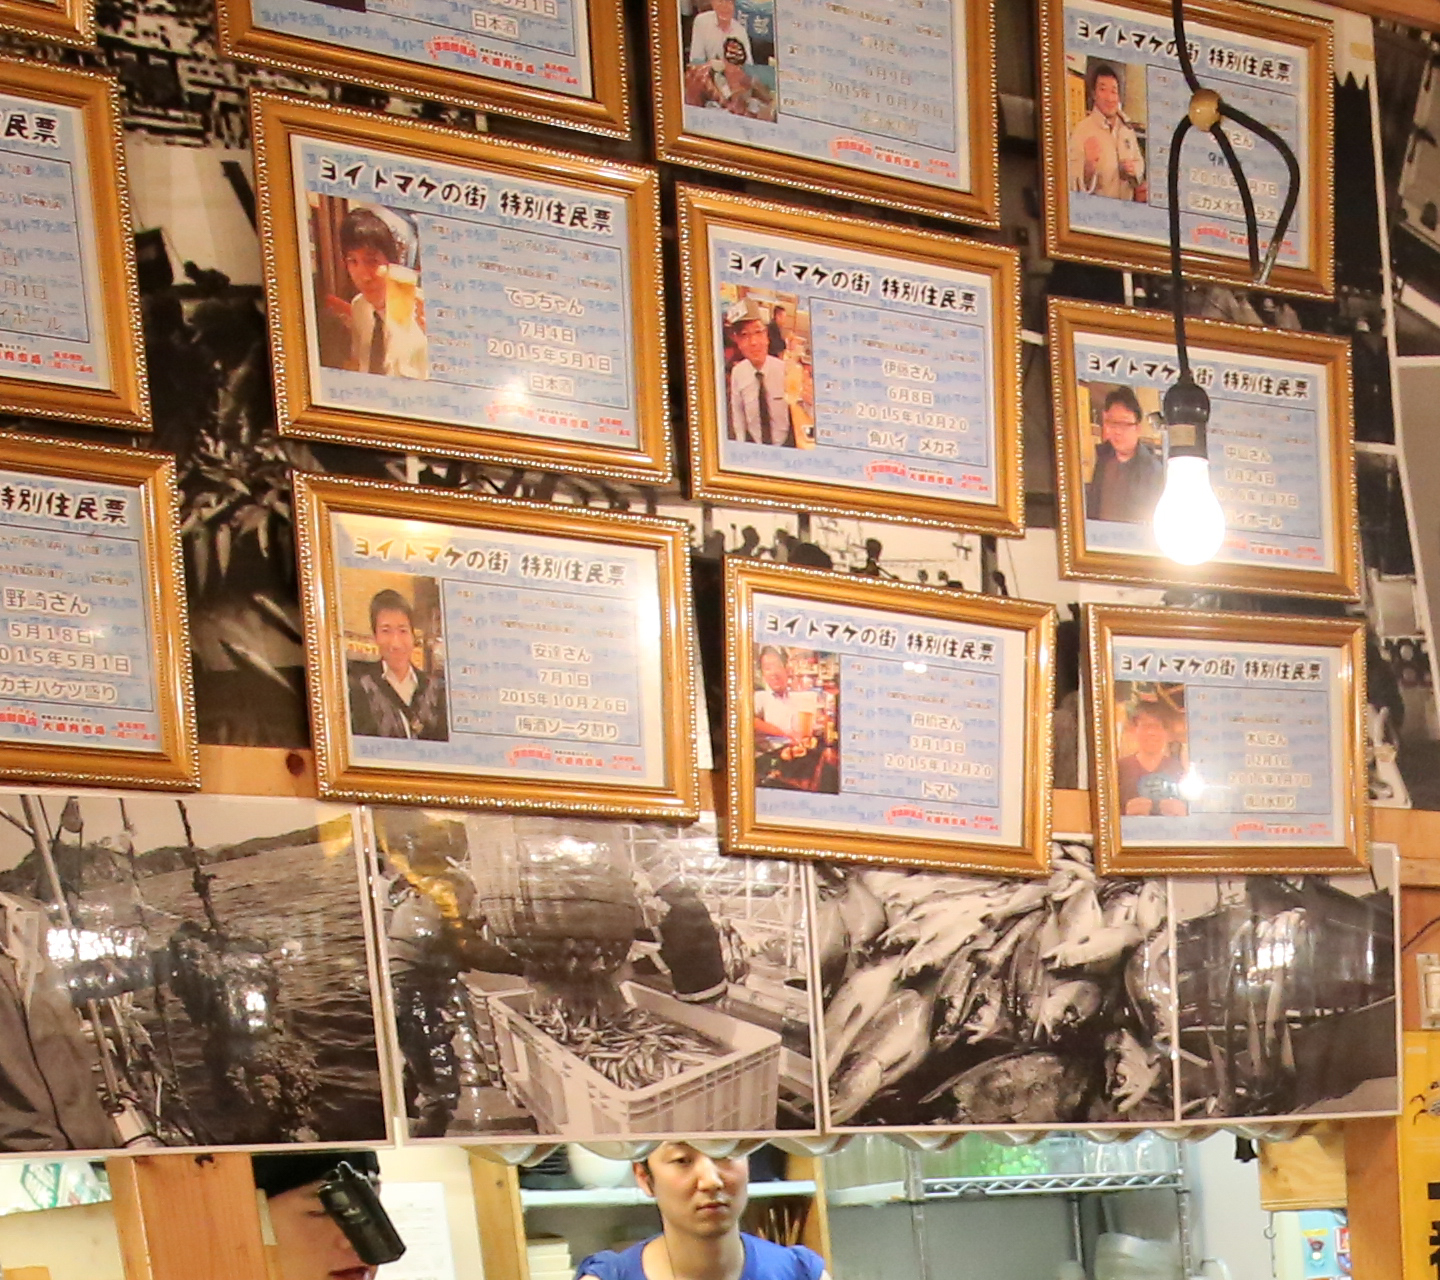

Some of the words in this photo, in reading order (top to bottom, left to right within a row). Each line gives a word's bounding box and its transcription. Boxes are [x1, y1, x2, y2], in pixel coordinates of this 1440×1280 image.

[1208, 49, 1292, 82] 特別住民票
[320, 158, 487, 209] ヨイトマケの街
[499, 191, 613, 233] 特別住民票
[728, 251, 872, 295] ヨイトマケの街
[881, 277, 978, 314] 特別住民票
[505, 288, 584, 317] てっちゃん
[520, 321, 575, 344] 7月4日
[488, 340, 612, 373] 2015年5月1日
[1089, 354, 1214, 387] ヨイトマケ街
[1223, 370, 1309, 398] 特別住民票
[889, 386, 934, 406] 6月8日
[354, 537, 510, 575] ヨイトマケの街
[521, 556, 626, 587] 特別住民票
[10, 625, 91, 645] 5月18日
[766, 615, 897, 649] ヨイトマケの街
[906, 632, 996, 664] 特別住民票
[539, 670, 591, 688] 7月1日
[1121, 655, 1235, 678] ヨイトマケの街
[1244, 658, 1321, 681] 特別住民票
[500, 690, 628, 714] 2015年10月26日
[911, 736, 966, 754] 3月13日
